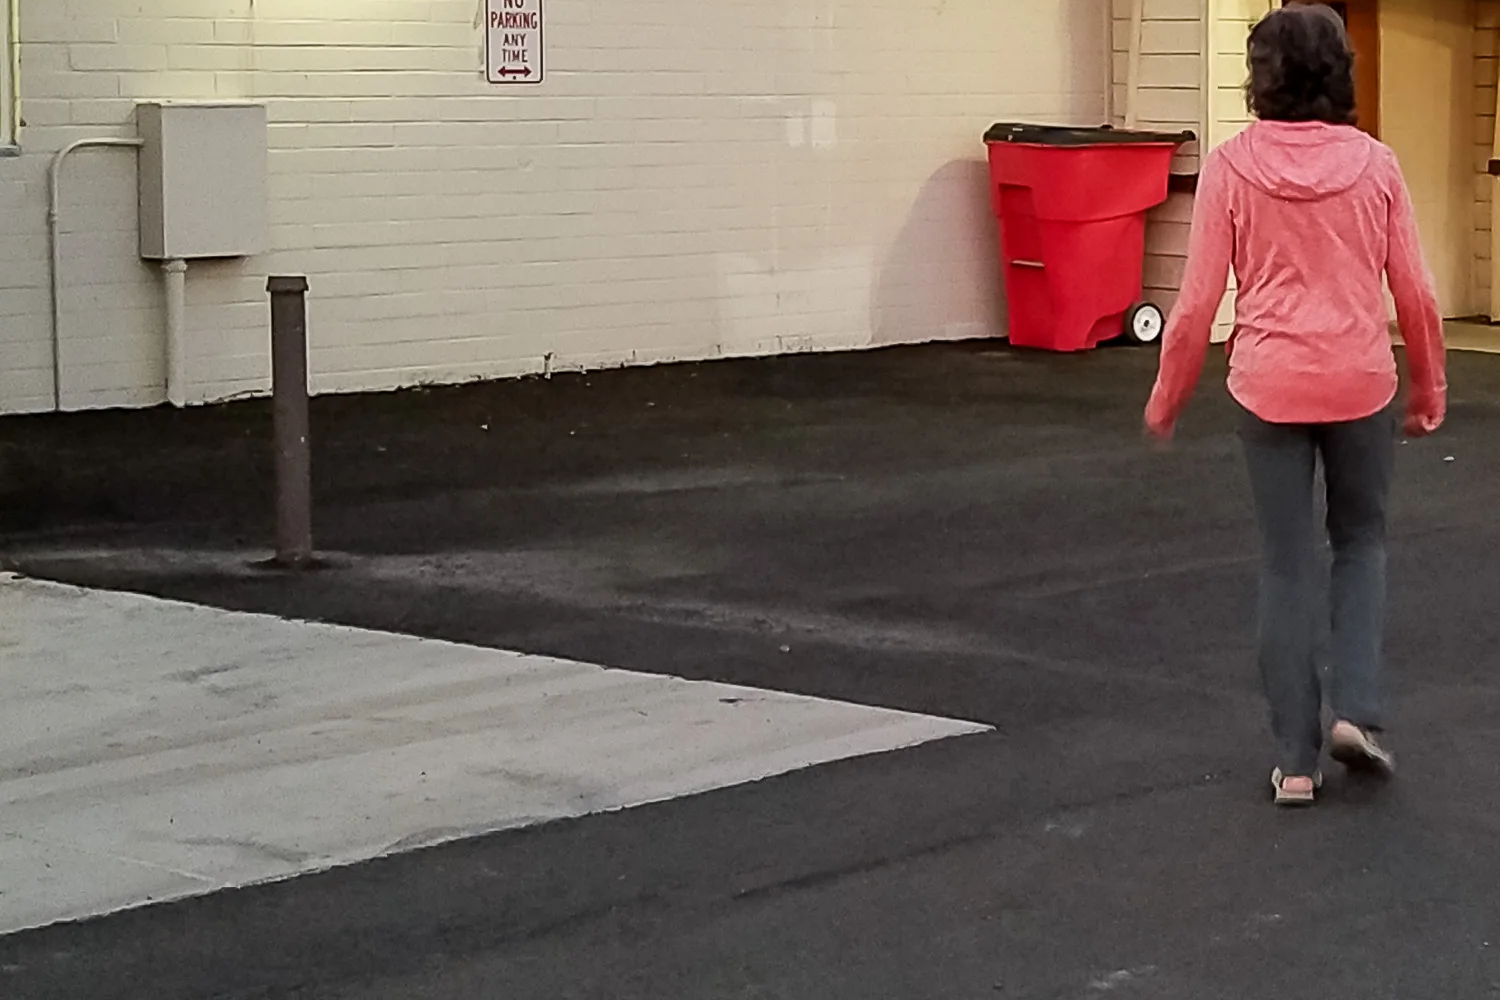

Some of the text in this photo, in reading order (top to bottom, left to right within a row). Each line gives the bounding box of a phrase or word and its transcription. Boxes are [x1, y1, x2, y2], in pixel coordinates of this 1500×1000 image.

[491, 11, 537, 29] PARKING
[502, 33, 526, 47] ANY
[502, 49, 528, 63] TIME
